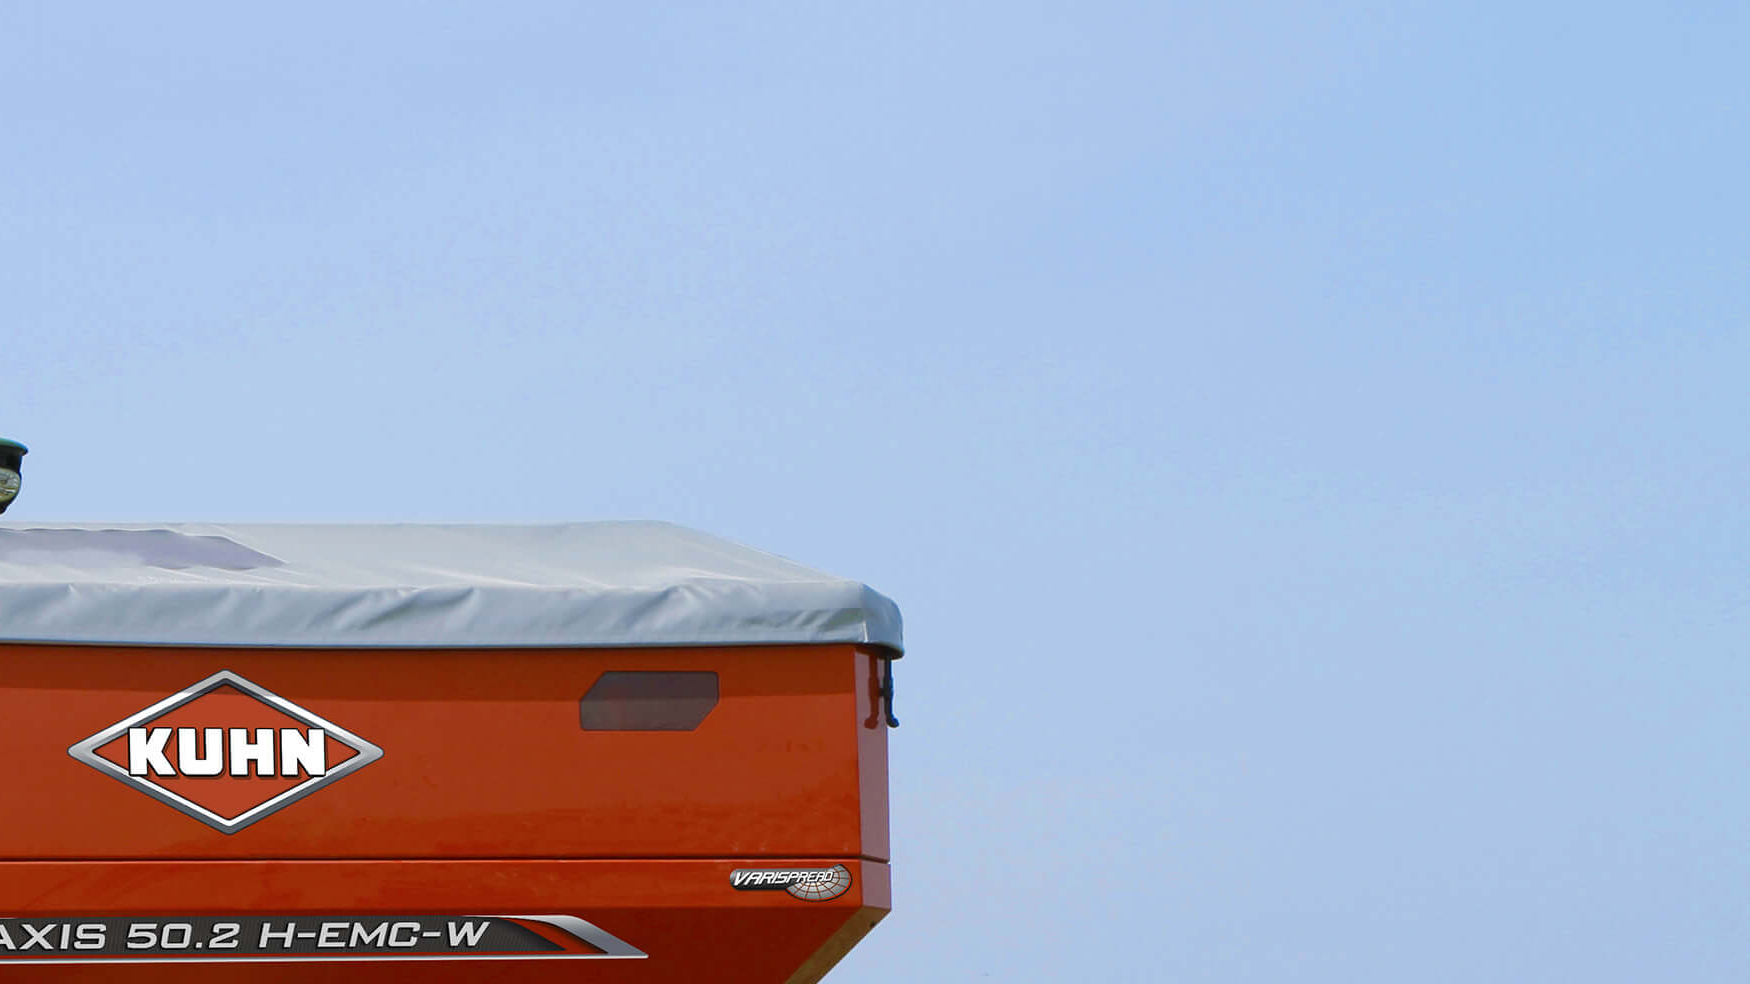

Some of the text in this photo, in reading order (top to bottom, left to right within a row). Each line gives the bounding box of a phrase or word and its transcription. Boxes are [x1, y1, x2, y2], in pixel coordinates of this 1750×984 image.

[128, 726, 326, 778] KUHN
[734, 871, 834, 886] VARISPREAD
[126, 922, 240, 949] 50.2
[258, 921, 490, 948] H-EMC-W
